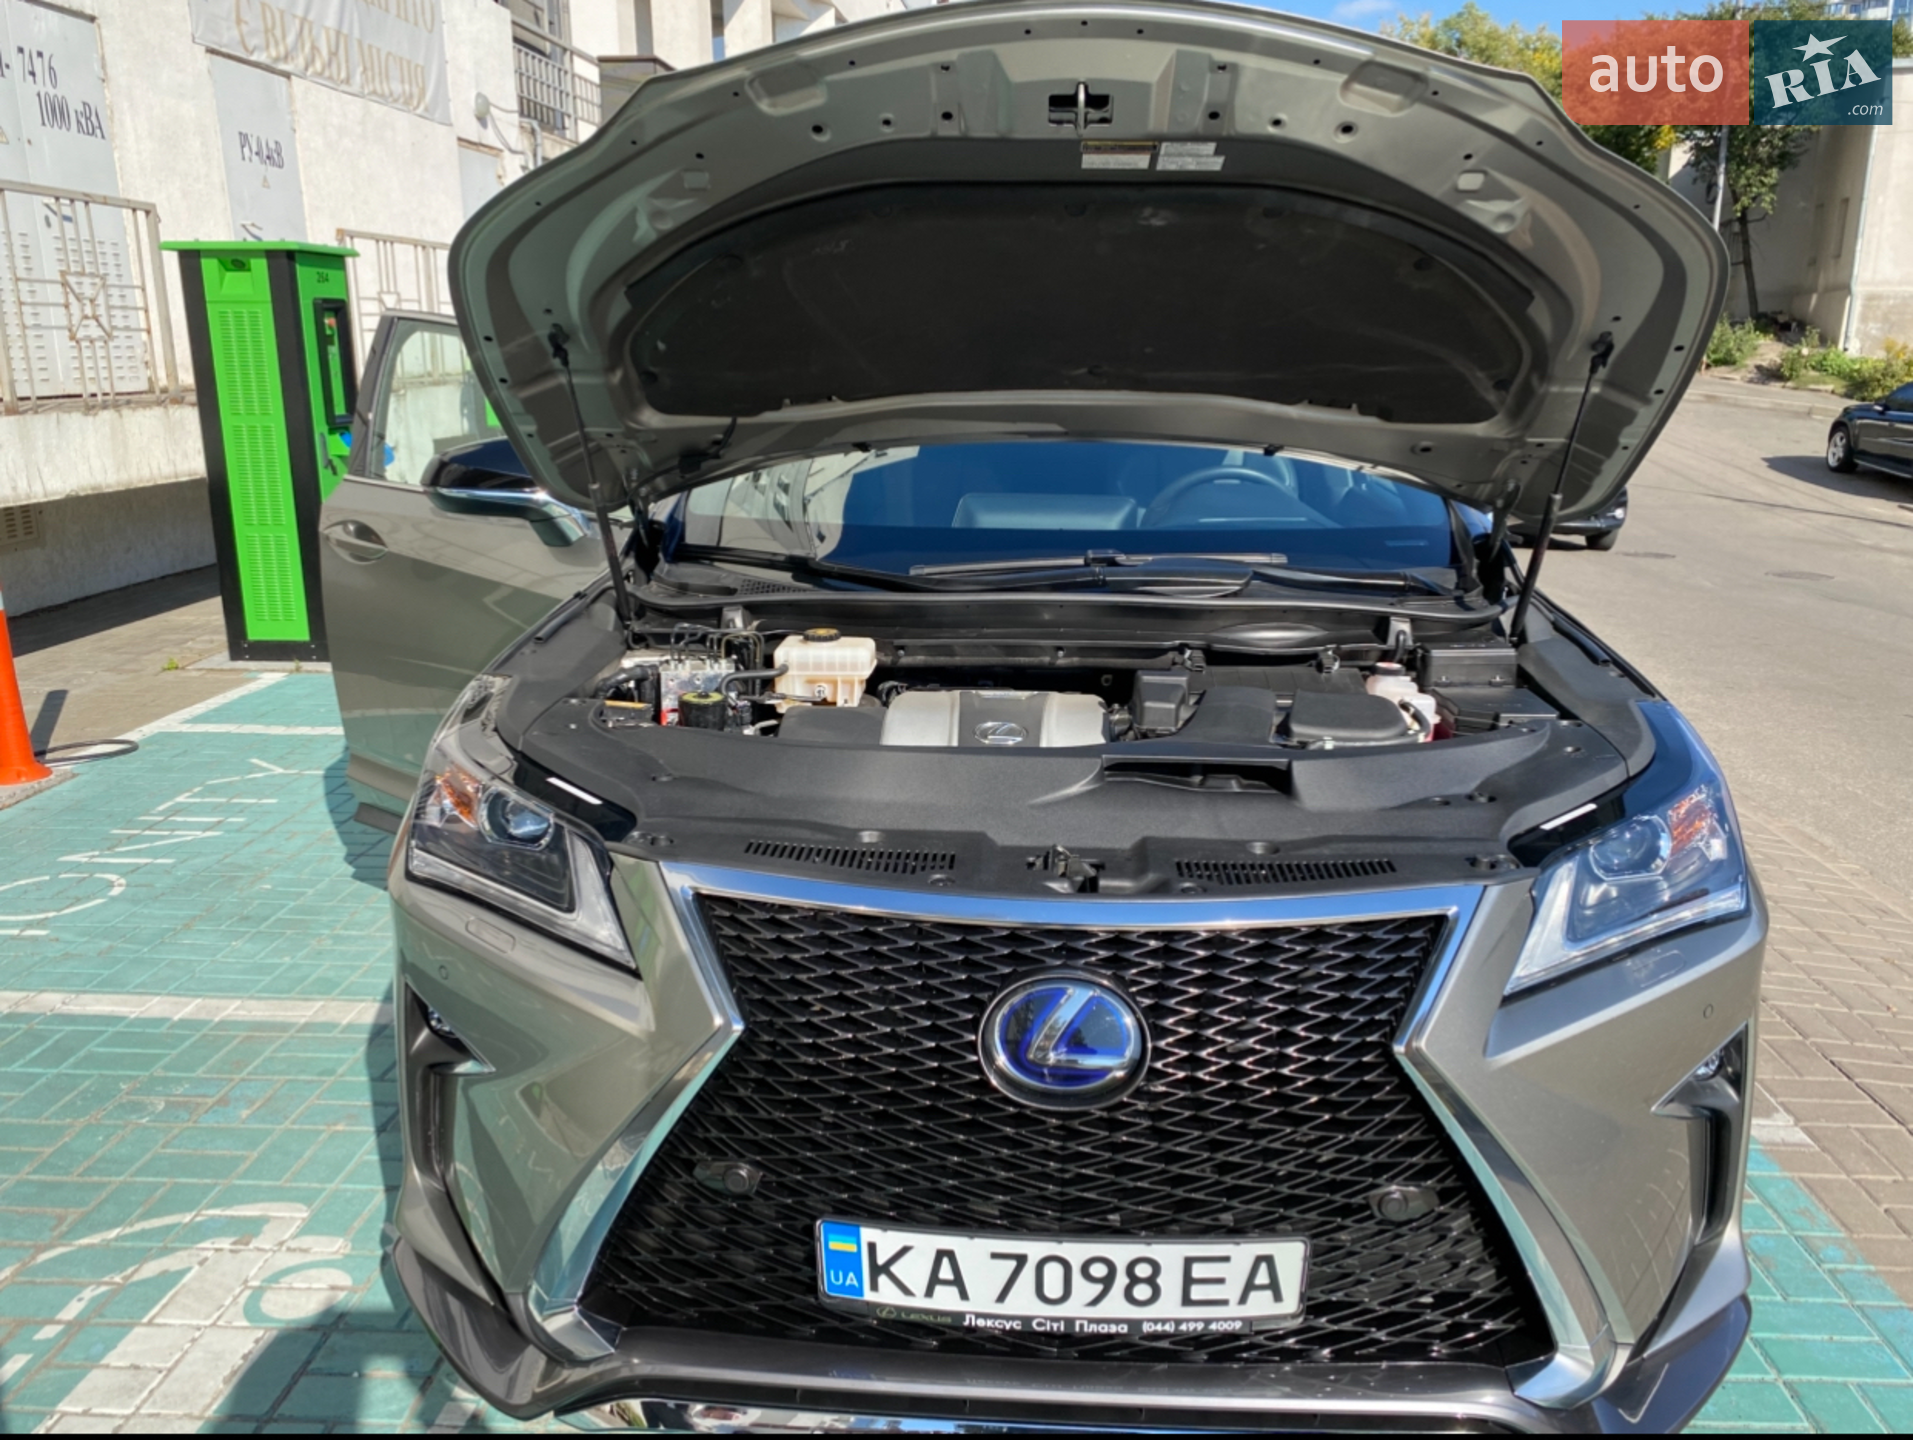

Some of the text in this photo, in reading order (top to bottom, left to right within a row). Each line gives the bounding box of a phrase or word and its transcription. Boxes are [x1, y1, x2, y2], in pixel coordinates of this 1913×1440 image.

[36, 90, 71, 132] 1000
[829, 1269, 859, 1288] UA
[867, 1242, 1284, 1307] KA 7098 EA
[901, 1311, 952, 1324] LEXUS
[962, 1313, 1022, 1331] Лексус
[1075, 1320, 1128, 1333] Плаза
[1142, 1321, 1176, 1333] (044)
[1178, 1321, 1205, 1332] 499
[1208, 1320, 1243, 1331] 4009
